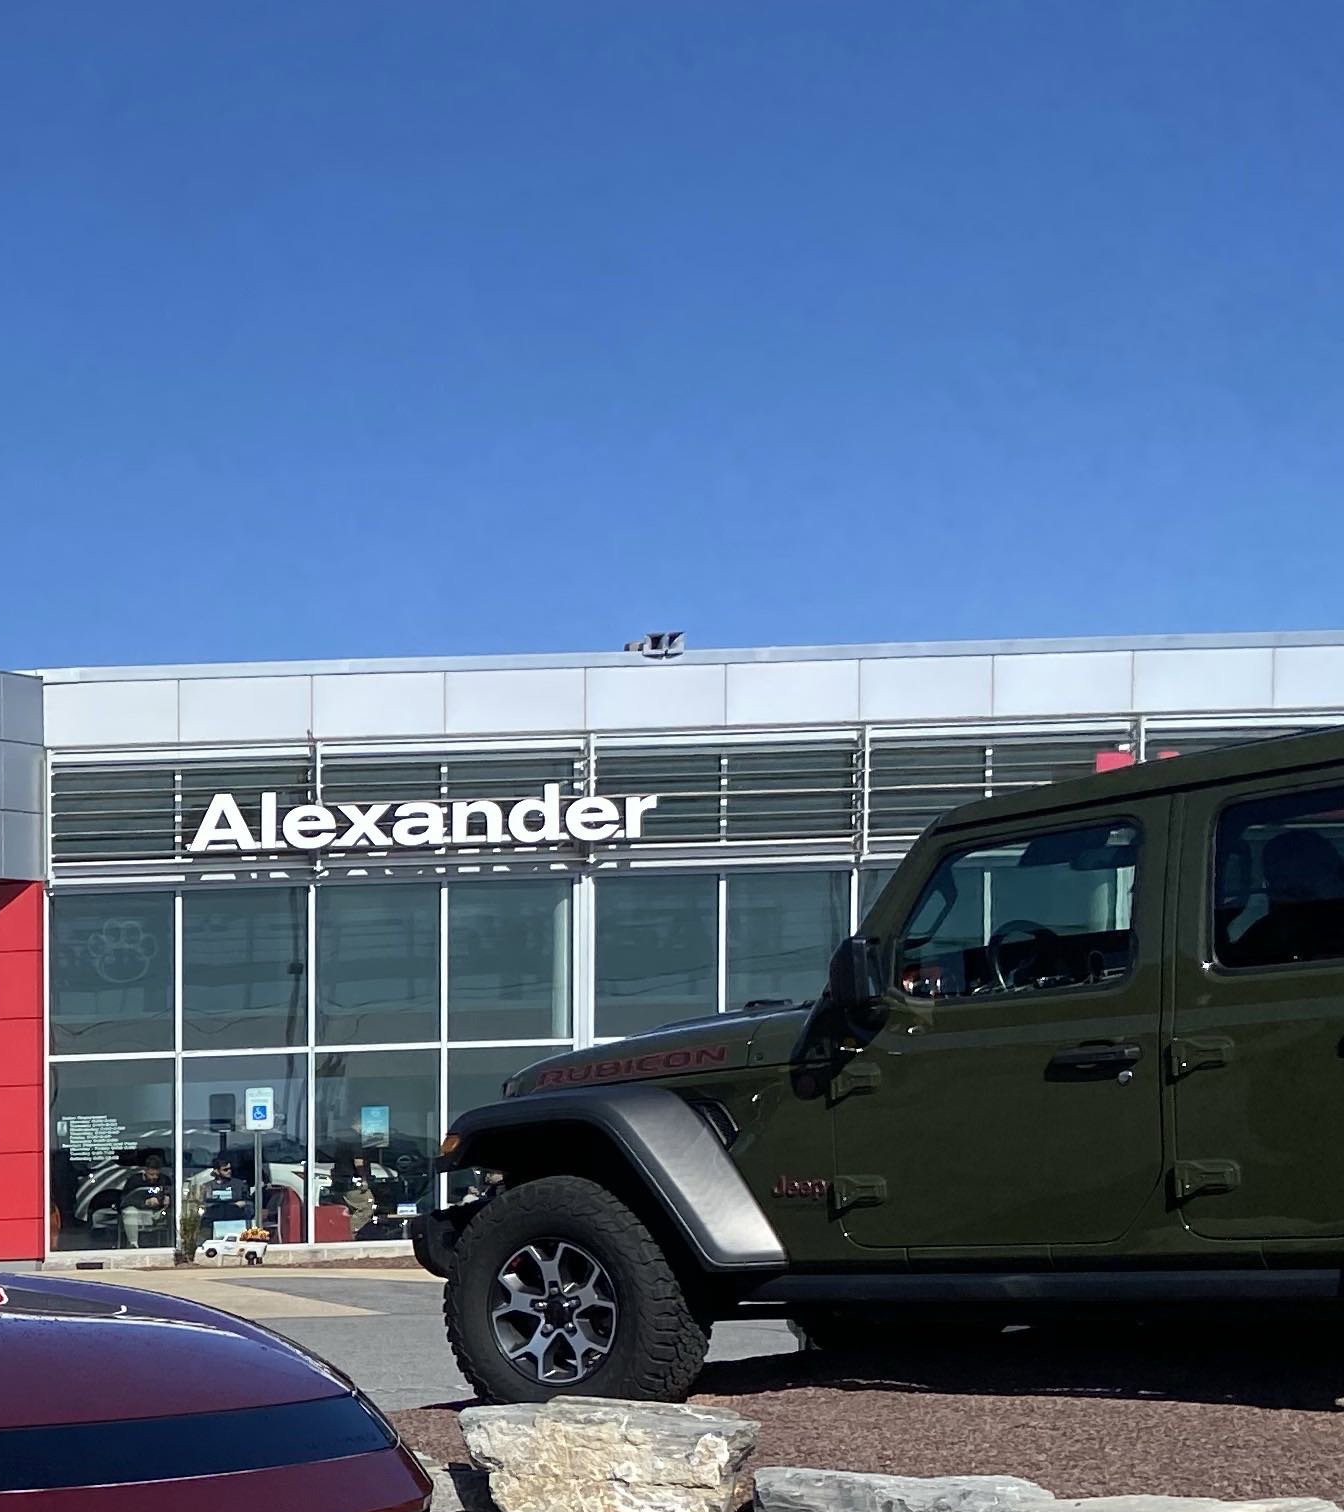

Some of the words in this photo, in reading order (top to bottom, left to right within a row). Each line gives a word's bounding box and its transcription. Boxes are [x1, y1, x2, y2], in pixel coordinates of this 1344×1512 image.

[188, 783, 657, 852] Alexander
[537, 1045, 729, 1089] RUBICON
[773, 1175, 829, 1201] Jeep
